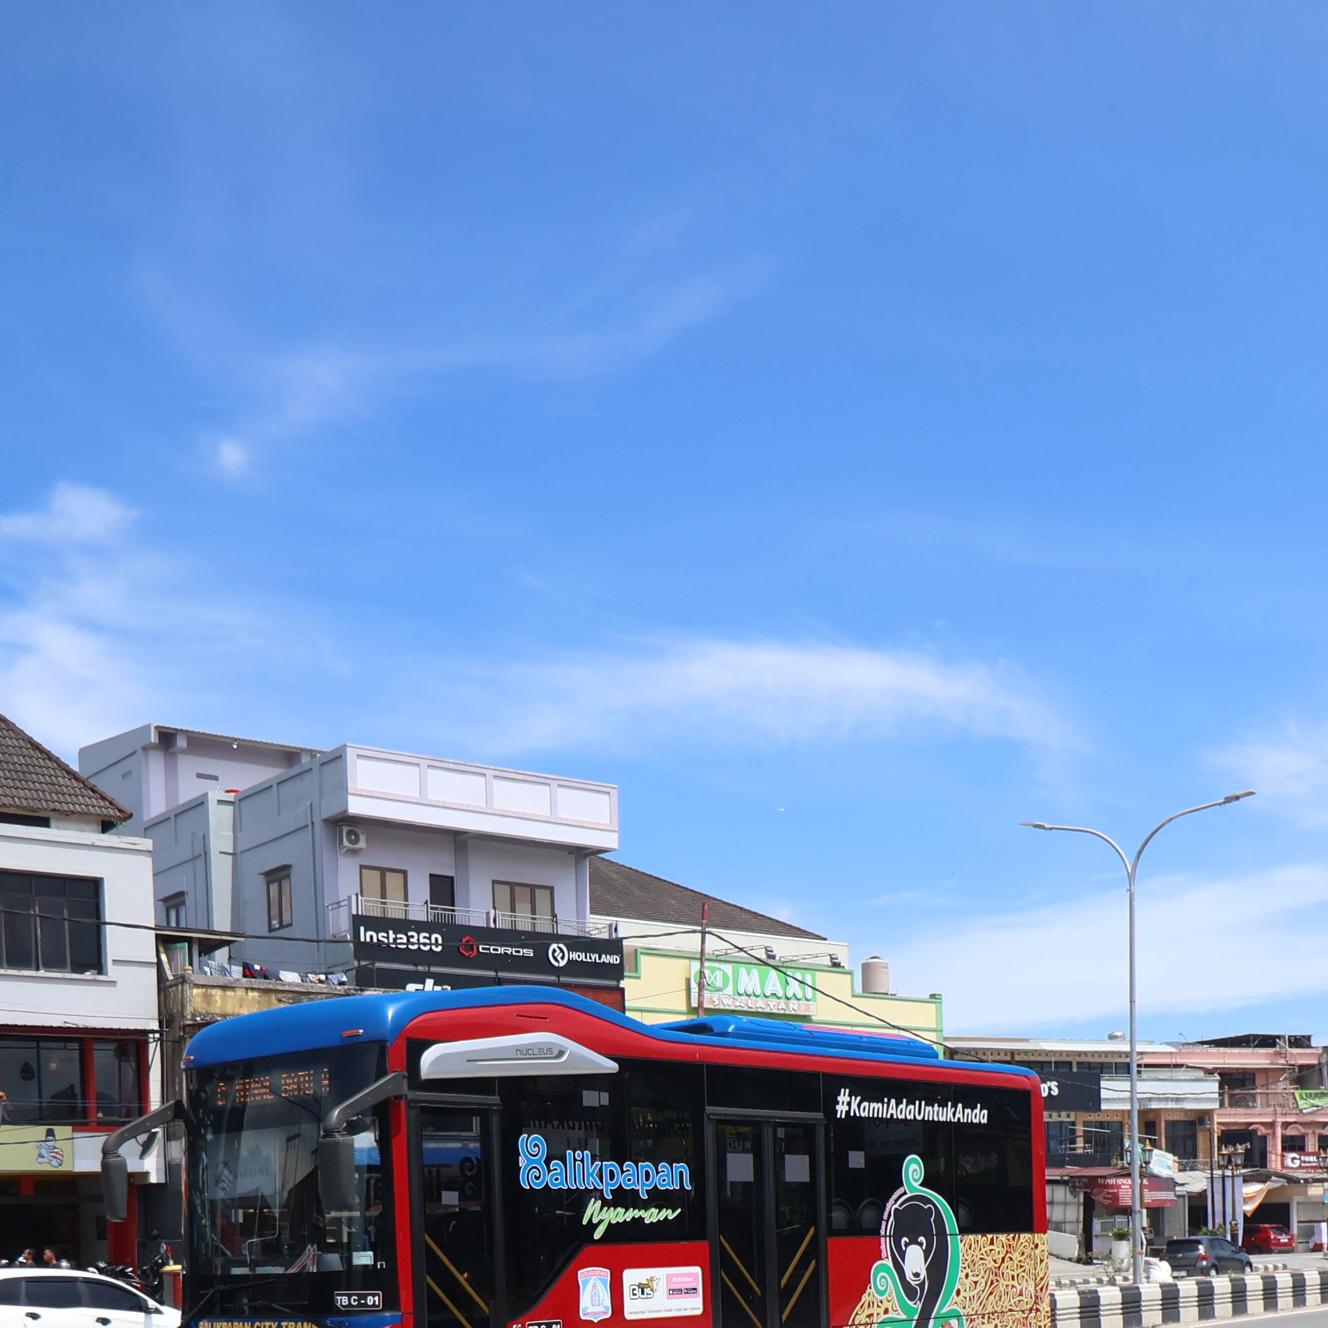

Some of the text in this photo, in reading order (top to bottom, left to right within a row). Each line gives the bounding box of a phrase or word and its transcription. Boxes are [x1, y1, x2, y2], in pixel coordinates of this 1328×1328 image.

[359, 926, 443, 952] Insta360
[479, 945, 534, 958] COROS
[569, 951, 621, 965] HOLLYLAND
[737, 967, 813, 1001] MAXI
[712, 997, 799, 1013] SWALAYAN
[515, 1047, 554, 1057] NUCLEUS
[835, 1088, 989, 1124] #KamiAdaUntukAnda
[518, 1134, 692, 1199] Balikpapan
[582, 1198, 681, 1240] Nyaman
[336, 1295, 348, 1306] TB
[350, 1295, 359, 1306] C
[366, 1295, 379, 1306] 01
